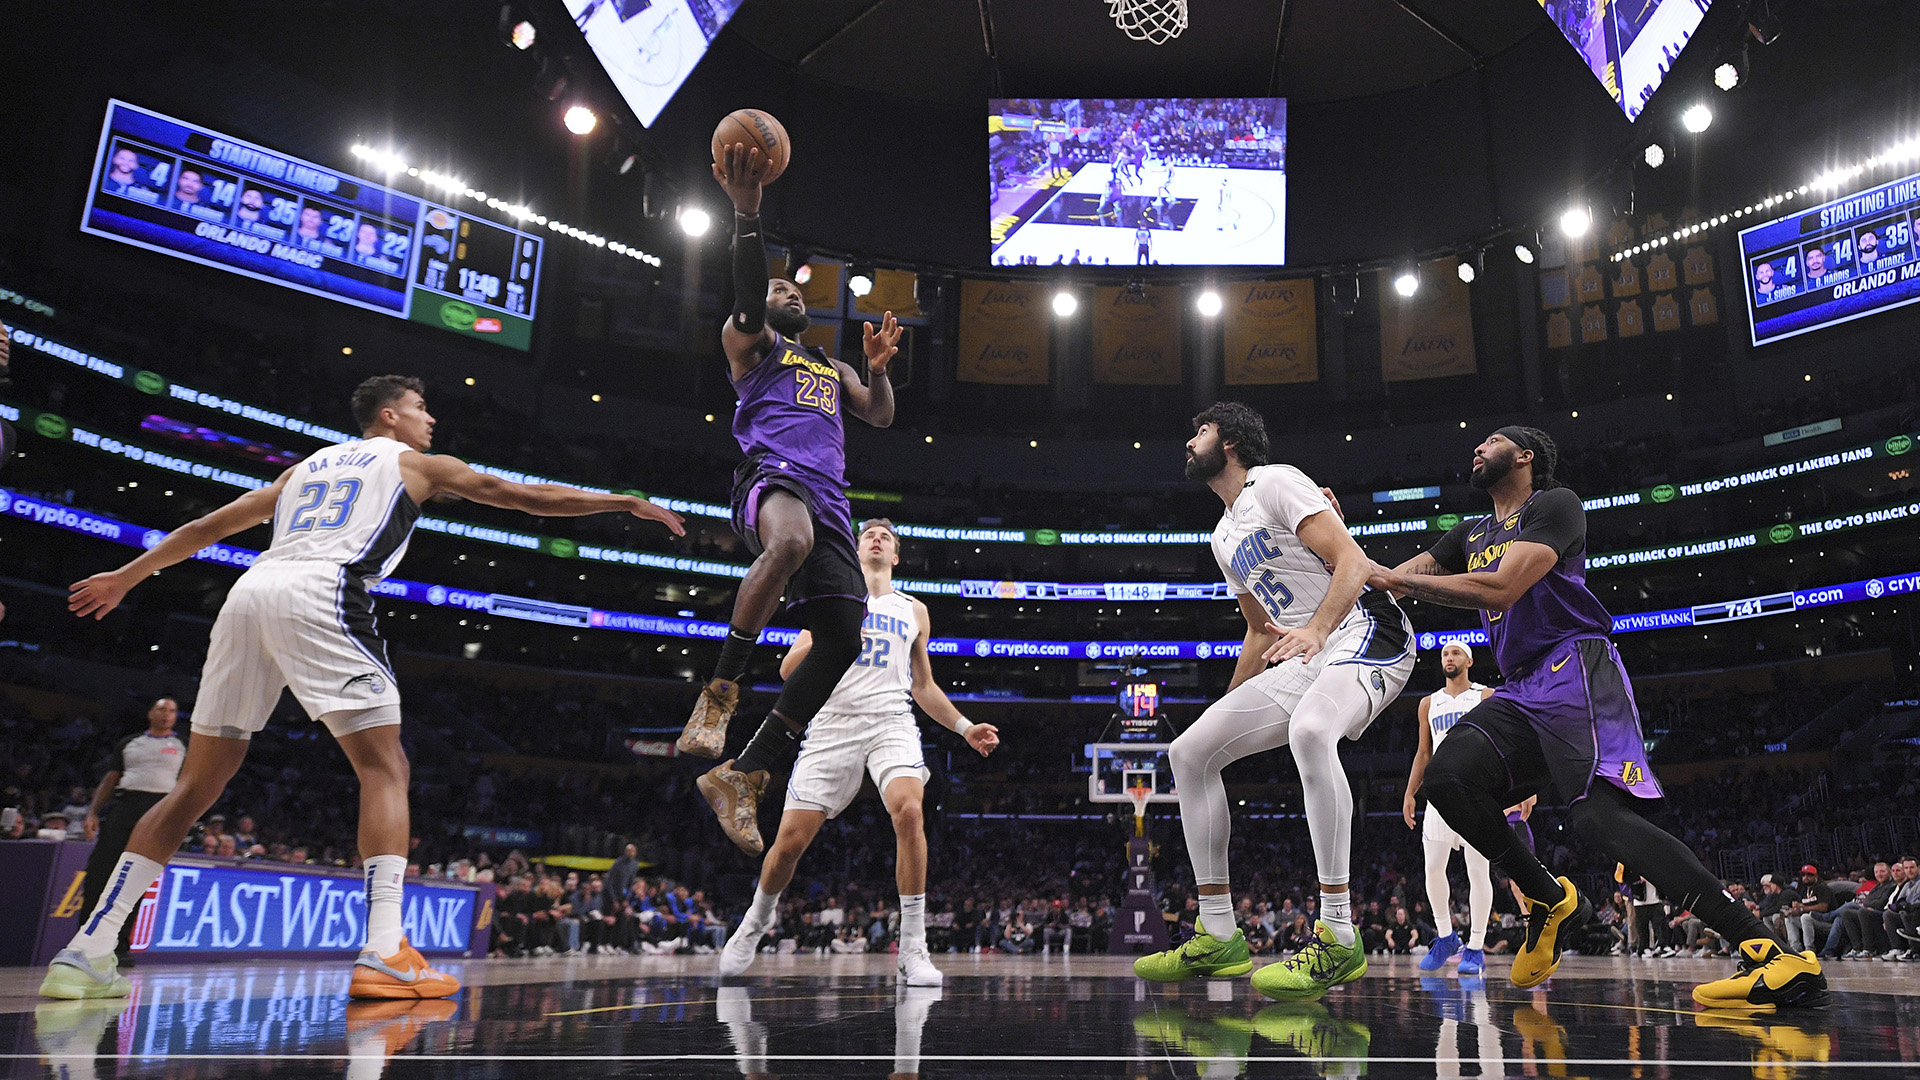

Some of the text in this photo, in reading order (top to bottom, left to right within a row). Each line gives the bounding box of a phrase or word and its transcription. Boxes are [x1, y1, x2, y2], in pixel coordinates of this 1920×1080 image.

[150, 162, 171, 187] 4
[209, 139, 340, 194] STARTING LINEUP
[211, 180, 237, 207] 14
[269, 198, 298, 225] 35
[1820, 191, 1885, 228] STARTING
[327, 215, 355, 243] 23
[1885, 221, 1909, 249] 35
[195, 222, 272, 254] ORLANDO
[271, 244, 324, 269] MAGIC
[382, 231, 409, 260] 22
[1833, 238, 1853, 265] 14
[1785, 256, 1797, 278] 4
[1824, 269, 1850, 284] HARRIS
[1833, 270, 1897, 299] ORLANDO
[1245, 287, 1295, 304] LAKERS
[1247, 343, 1297, 361] LAKERS
[170, 384, 198, 403] THE
[796, 370, 836, 415] 23
[72, 427, 100, 447] THE
[1801, 425, 1822, 436] Health
[309, 452, 377, 473] DA SILVA
[1680, 484, 1703, 497] THE
[1703, 475, 1740, 492] GO-TO
[1740, 467, 1778, 485] SNACK
[1779, 463, 1795, 477] OF
[1796, 454, 1841, 473] LAKERS
[1841, 446, 1873, 463] FANS
[1388, 487, 1424, 497] AMERICAN
[1393, 493, 1424, 501] EXPRESS
[1612, 492, 1641, 507] FANS
[287, 477, 363, 535] 23
[13, 499, 121, 539] crypto.com
[447, 522, 465, 535] OF
[1362, 522, 1400, 536] LAKERS
[1401, 519, 1427, 532] FANS
[1799, 521, 1823, 536] THE
[1824, 514, 1864, 531] GO-TO
[1865, 505, 1908, 524] SNACK
[912, 527, 946, 540] SNACK
[946, 529, 960, 540] OF
[961, 529, 998, 542] LAKERS
[999, 531, 1026, 542] FANS
[1060, 533, 1081, 544] THE
[1080, 533, 1113, 544] GO-TO
[1113, 533, 1147, 544] SNACK
[1147, 533, 1161, 544] OF
[1162, 533, 1198, 544] LAKERS
[578, 545, 601, 560] THE
[601, 549, 638, 564] GO-TO
[638, 553, 676, 569] SNACK
[676, 558, 692, 571] OF
[691, 560, 732, 576] LAKERS
[1592, 534, 1756, 569] GO-TO SNACK OF LAKERS FANS
[903, 580, 941, 593] LAKERS
[1036, 585, 1046, 598] 0
[1068, 588, 1096, 596] Lakers
[1110, 587, 1149, 598] 11:48
[1177, 588, 1202, 597] Magic
[1253, 569, 1294, 619] 35
[1726, 600, 1763, 618] 7:41
[855, 637, 890, 668] 22
[993, 642, 1069, 656] crypto.com
[1103, 643, 1179, 657] crypto.com
[1134, 696, 1155, 717] 14
